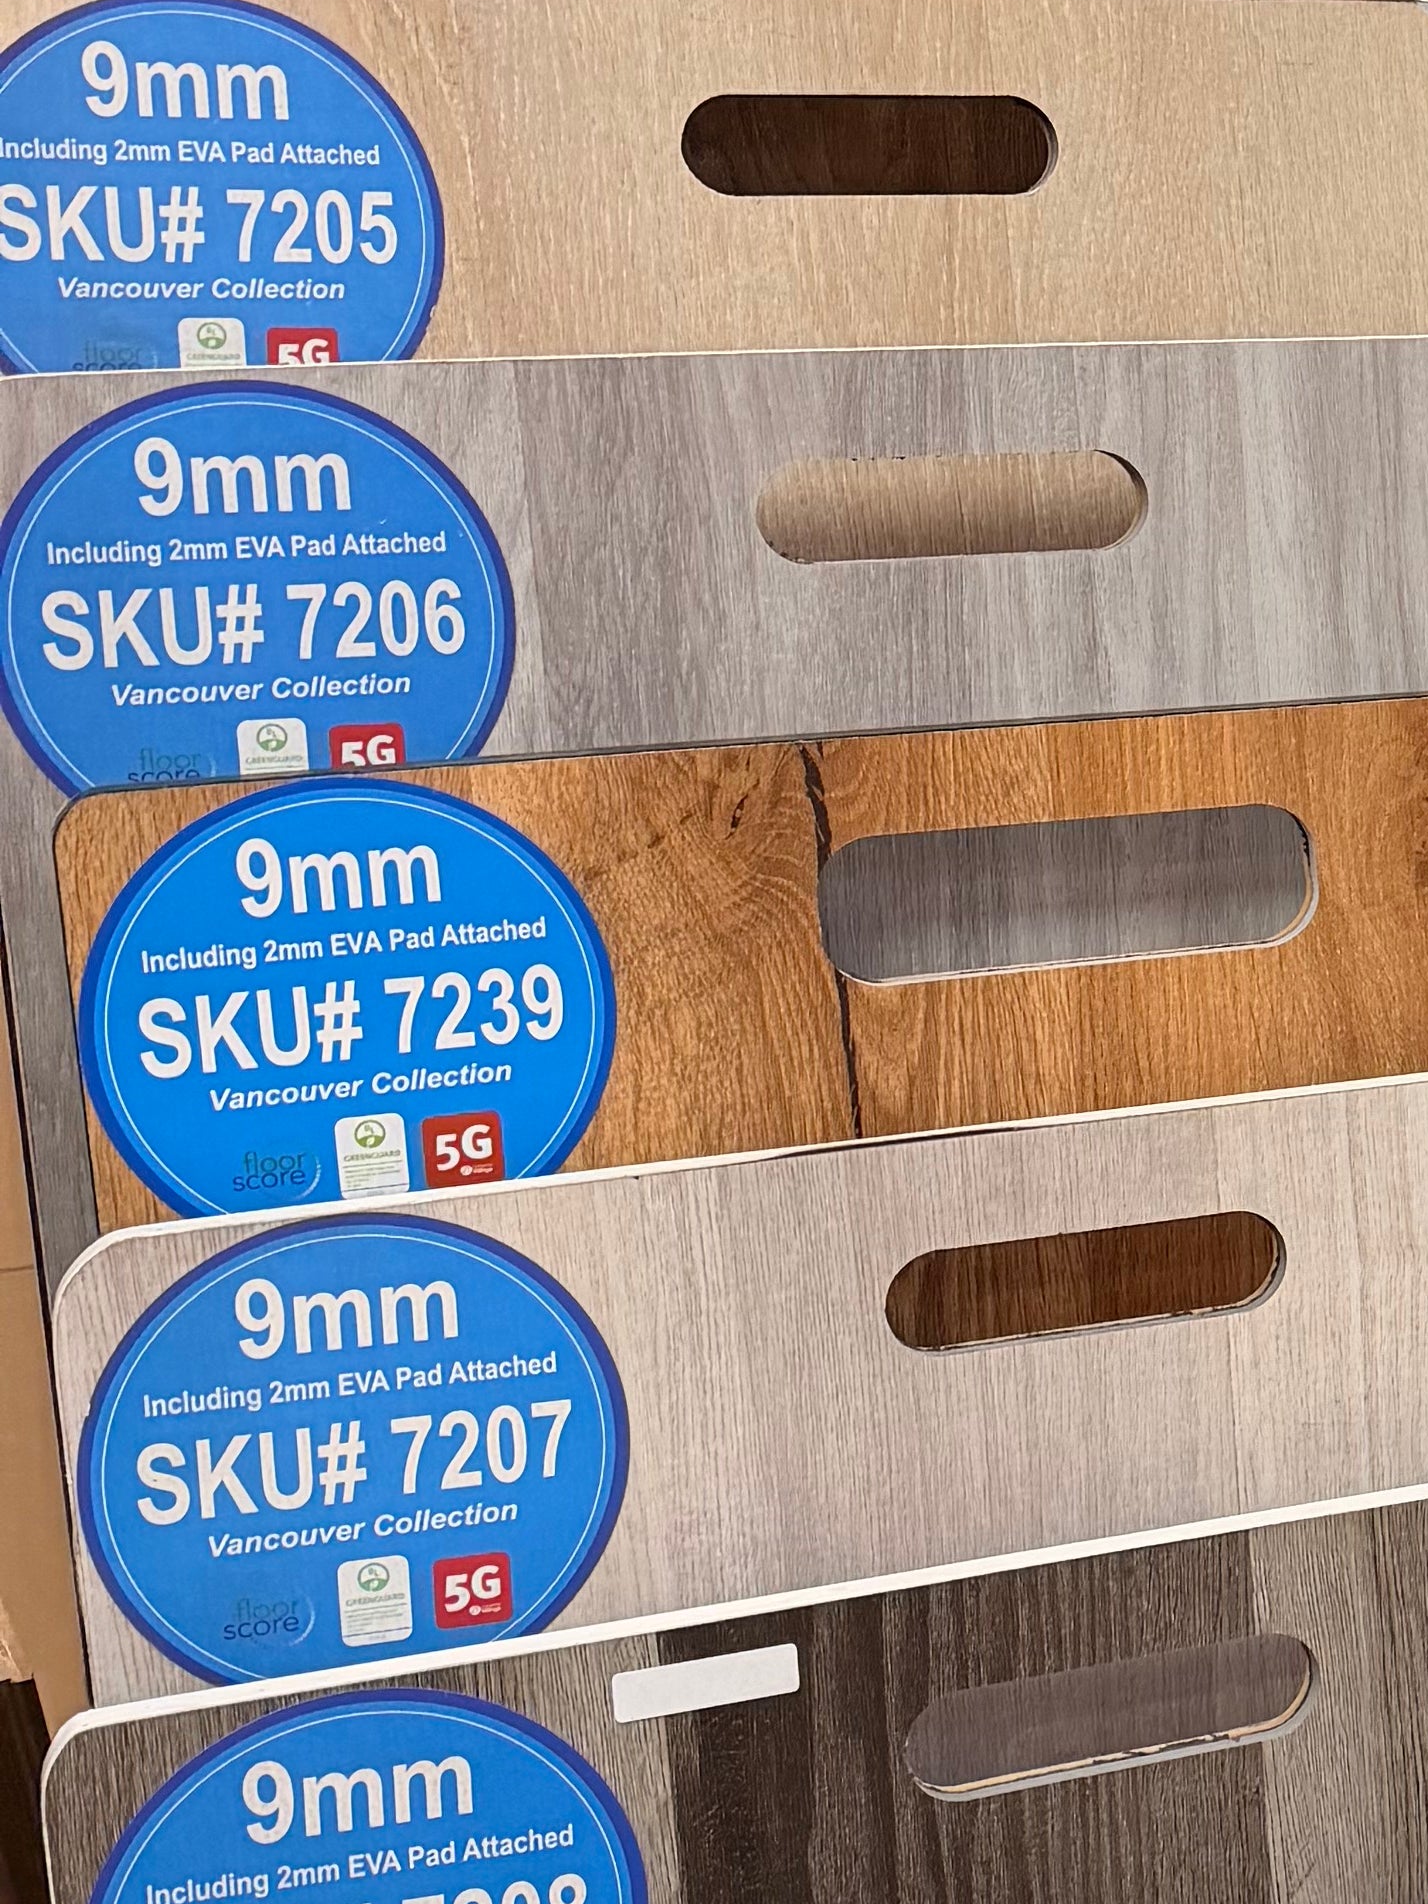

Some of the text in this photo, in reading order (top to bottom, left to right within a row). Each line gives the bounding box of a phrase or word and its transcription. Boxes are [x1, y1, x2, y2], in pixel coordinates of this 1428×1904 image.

[81, 40, 290, 121] 9mm
[0, 183, 398, 265] SKU# 7205
[133, 436, 352, 517] 9mm
[47, 530, 447, 567] Including 2mm EVA Pad Attached
[41, 578, 466, 671] SKU# 7206
[111, 673, 411, 706] Vancouver Collection
[341, 732, 397, 768] 5G
[235, 837, 442, 919] 9mm
[138, 963, 564, 1079] SKU# 7239
[436, 1124, 493, 1171] 5G
[234, 1278, 459, 1360] 9mm
[136, 1398, 572, 1526] SKU# 7207
[444, 1564, 501, 1613] 5G
[242, 1755, 474, 1845] 9mm
